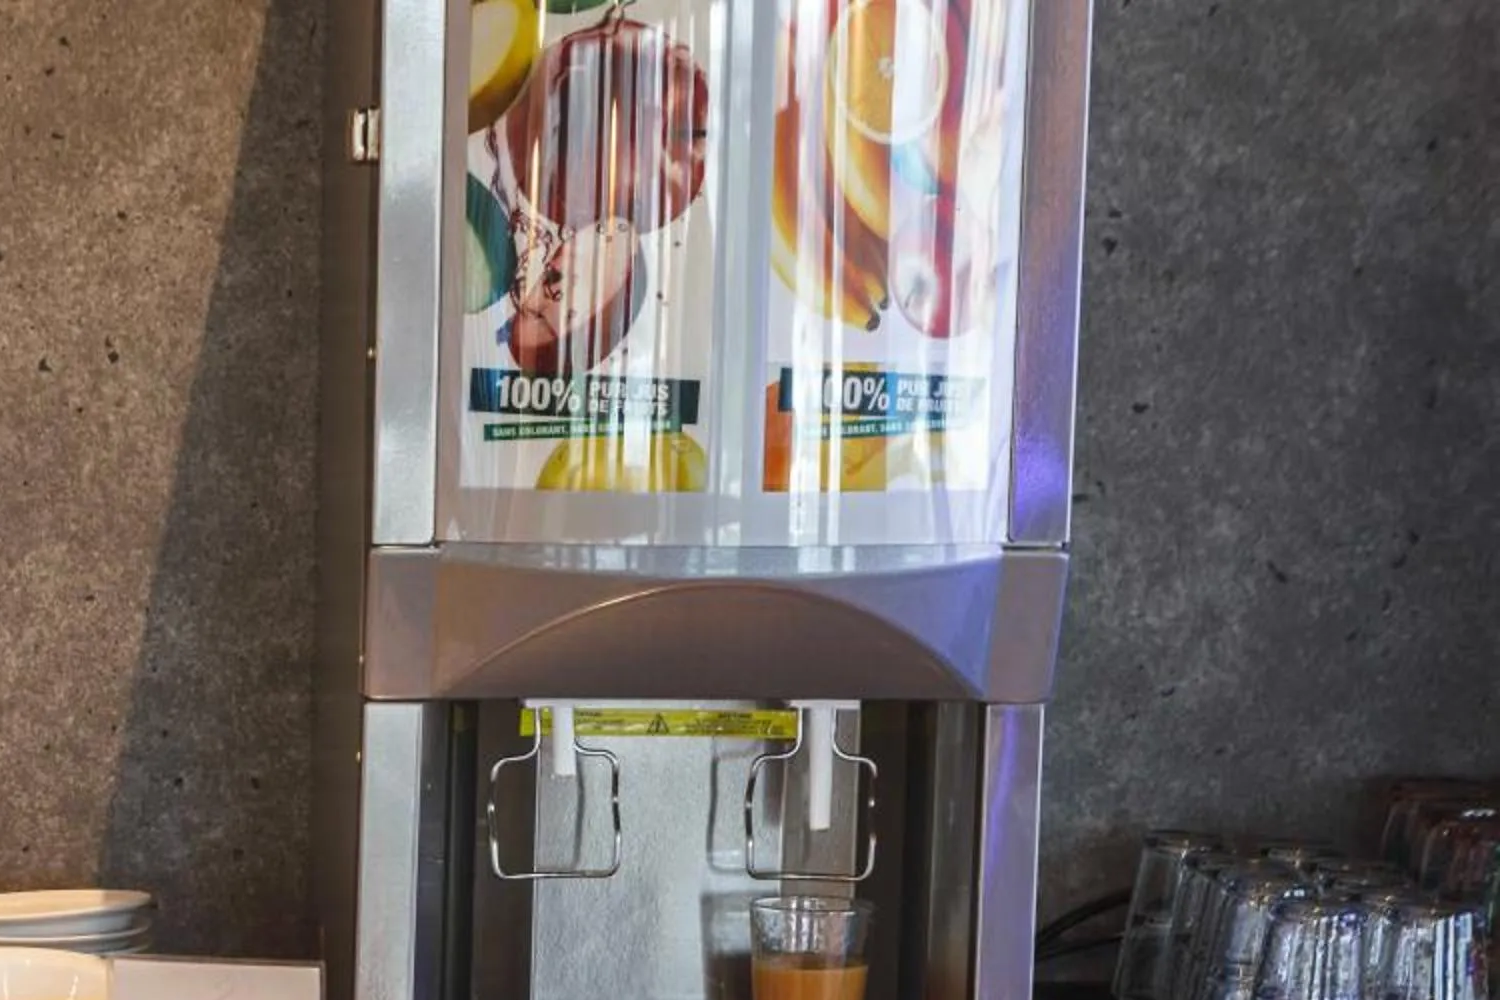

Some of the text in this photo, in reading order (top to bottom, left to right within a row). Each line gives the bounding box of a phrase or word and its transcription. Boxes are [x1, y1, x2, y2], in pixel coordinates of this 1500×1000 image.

[497, 376, 581, 413] 100%
[588, 399, 609, 413] DE
[806, 376, 891, 411] 00%
